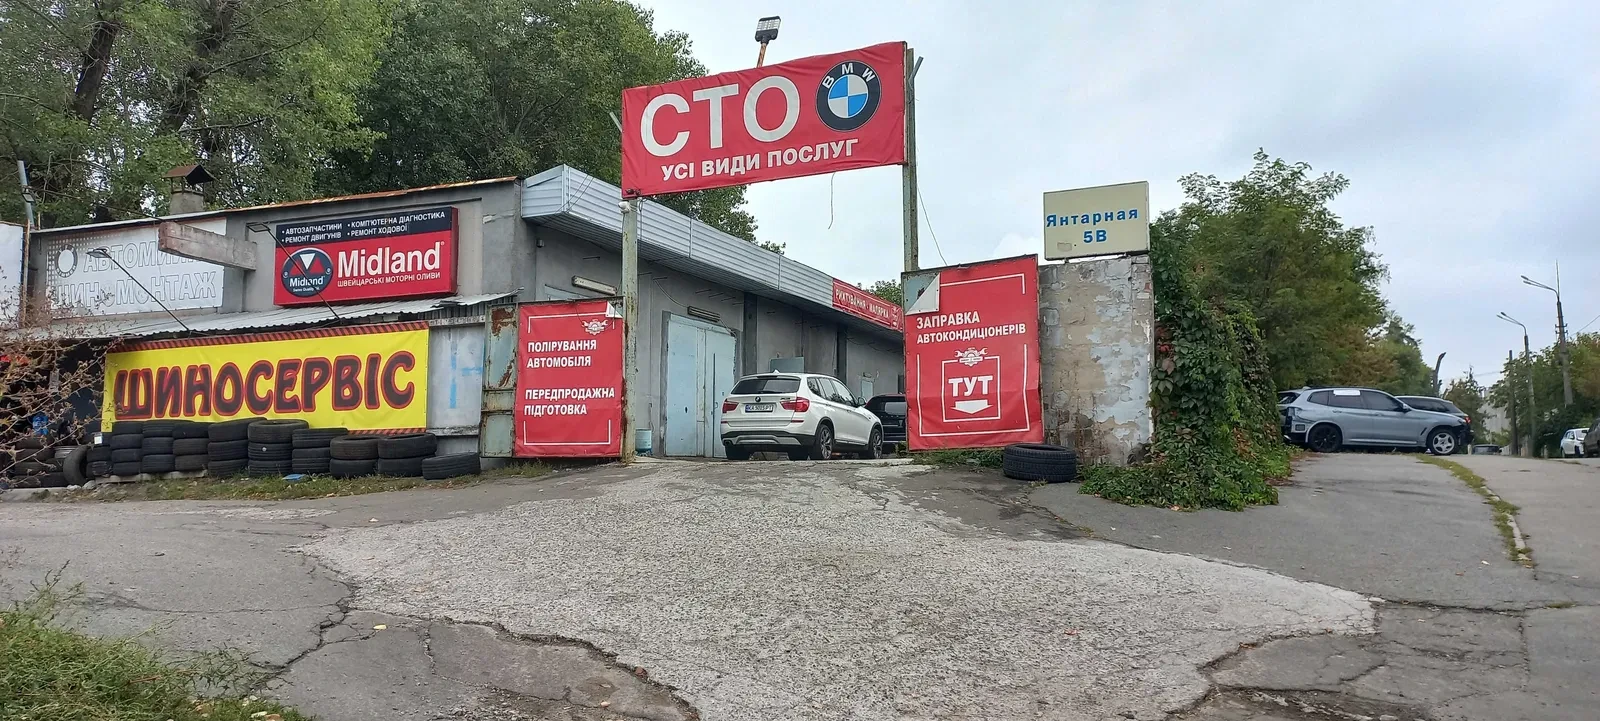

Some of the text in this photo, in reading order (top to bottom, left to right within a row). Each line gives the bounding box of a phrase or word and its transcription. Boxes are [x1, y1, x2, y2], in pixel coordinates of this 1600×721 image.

[822, 62, 876, 89] BMW
[640, 75, 800, 157] СТО
[661, 139, 858, 181] УСІ ВИДИ ПОСЛУГ
[398, 211, 445, 224] ДІАГНОСТИКА
[1046, 208, 1138, 227] Янтарная
[285, 222, 342, 235] АВТОЗАПЧАСТИНИ
[351, 223, 408, 237] РЕМОНТ ХОДОВОЇ
[1083, 230, 1107, 243] 5В
[285, 232, 341, 244] РЕМОНТ ДВИГУНІВ
[337, 241, 440, 278] Midland
[337, 271, 440, 288] ШВЕЙЦАРСЬКІ МОТОРНІ ОЛИВИ
[916, 311, 980, 329] ЗАПРАВКА
[916, 323, 1026, 344] АВТОКОНДИЦІОНЕРІВ
[527, 339, 597, 353] ПОЛІРУВАННЯ
[526, 356, 591, 369] АВТОМОБІЛЯ
[113, 350, 416, 420] ШИНОСЕРВІС
[948, 376, 993, 397] ТУТ
[525, 387, 616, 401] ПЕРЕДПРОДАЖНА
[523, 404, 587, 418] ПІДГОТОВКА
